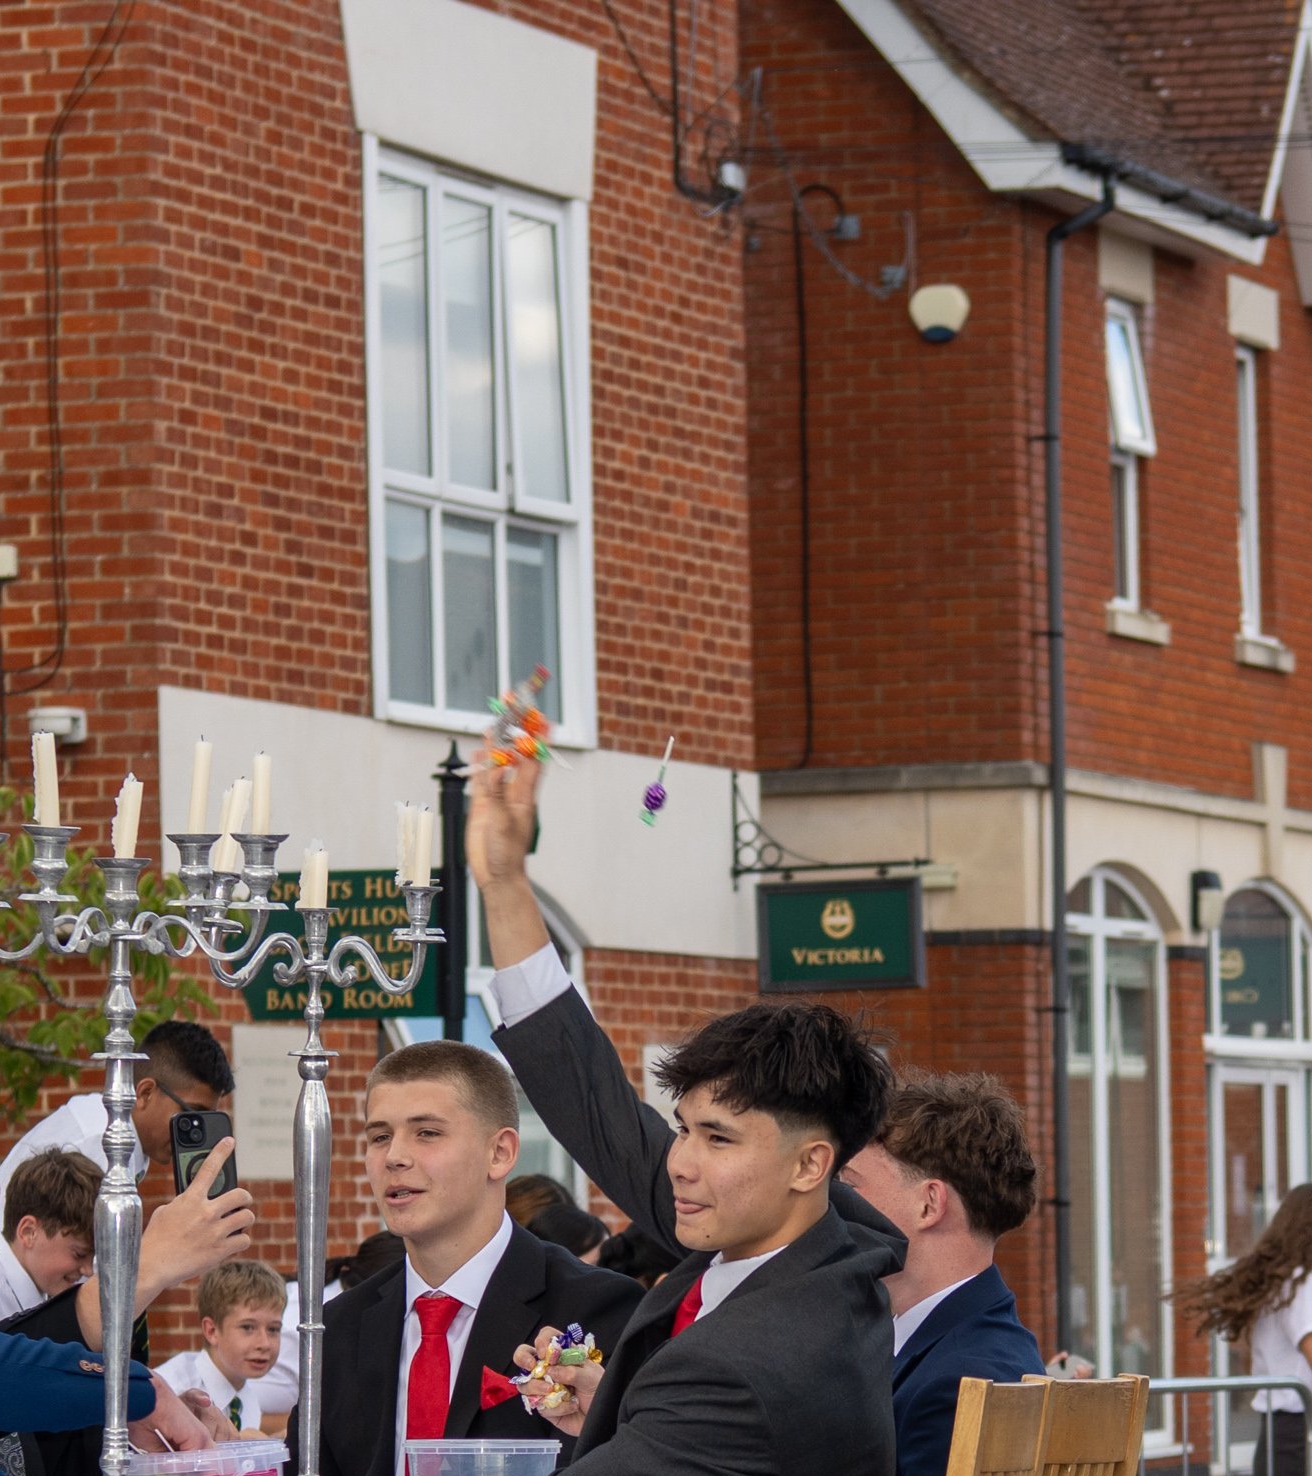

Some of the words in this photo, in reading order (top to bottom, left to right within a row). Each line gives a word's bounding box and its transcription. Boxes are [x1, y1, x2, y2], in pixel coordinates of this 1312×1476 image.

[271, 880, 352, 900] SPTS
[365, 877, 402, 899] HU
[326, 905, 412, 927] AVILION
[791, 948, 884, 965] VICTORIA
[267, 989, 332, 1010] BAND
[343, 988, 414, 1009] ROOM
